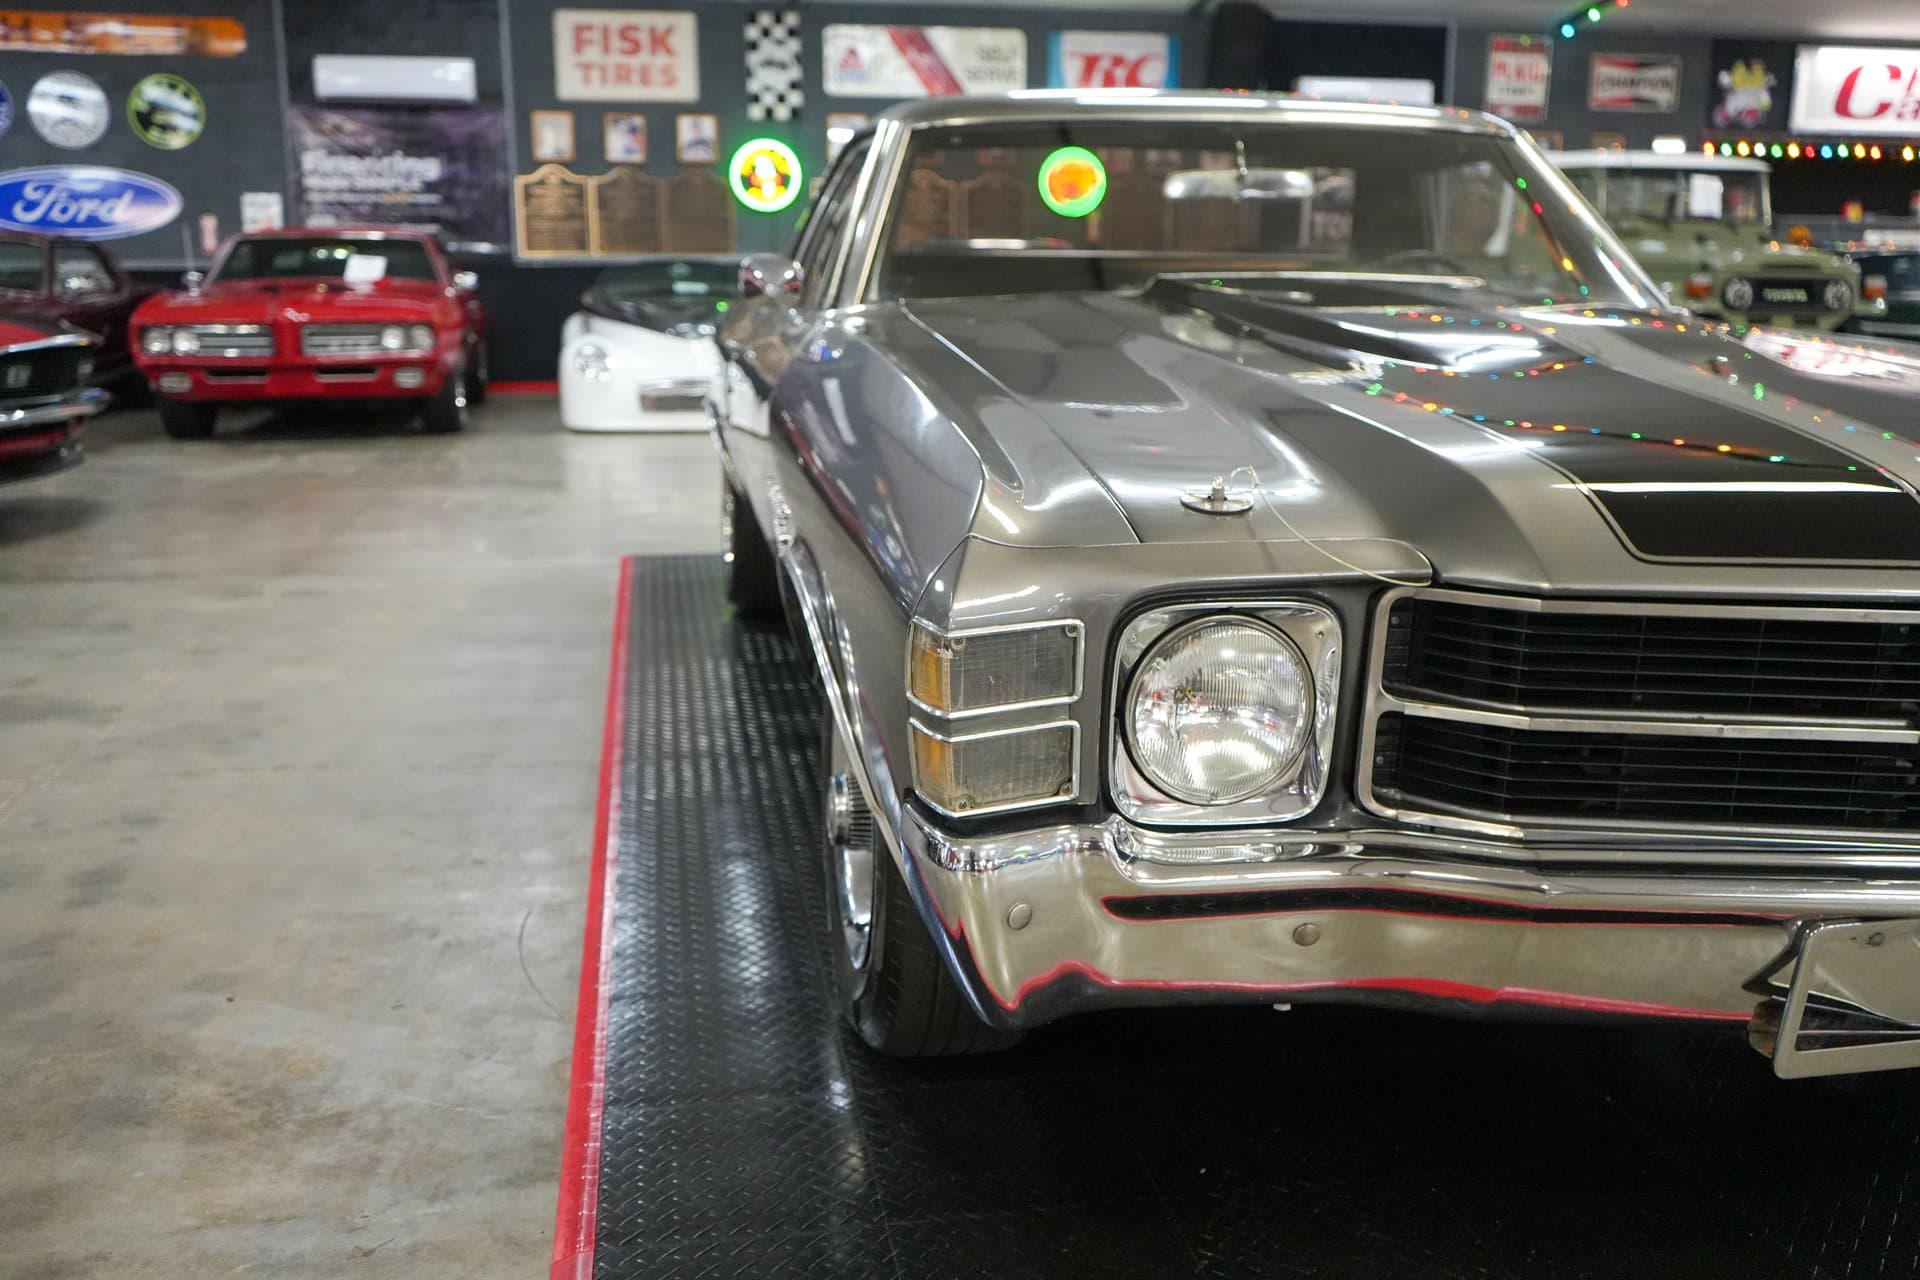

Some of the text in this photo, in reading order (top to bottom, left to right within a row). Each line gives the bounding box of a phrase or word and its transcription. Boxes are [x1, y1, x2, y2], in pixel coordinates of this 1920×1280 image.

[574, 23, 675, 56] FISK
[576, 62, 679, 87] TIRES
[12, 180, 135, 224] Ford
